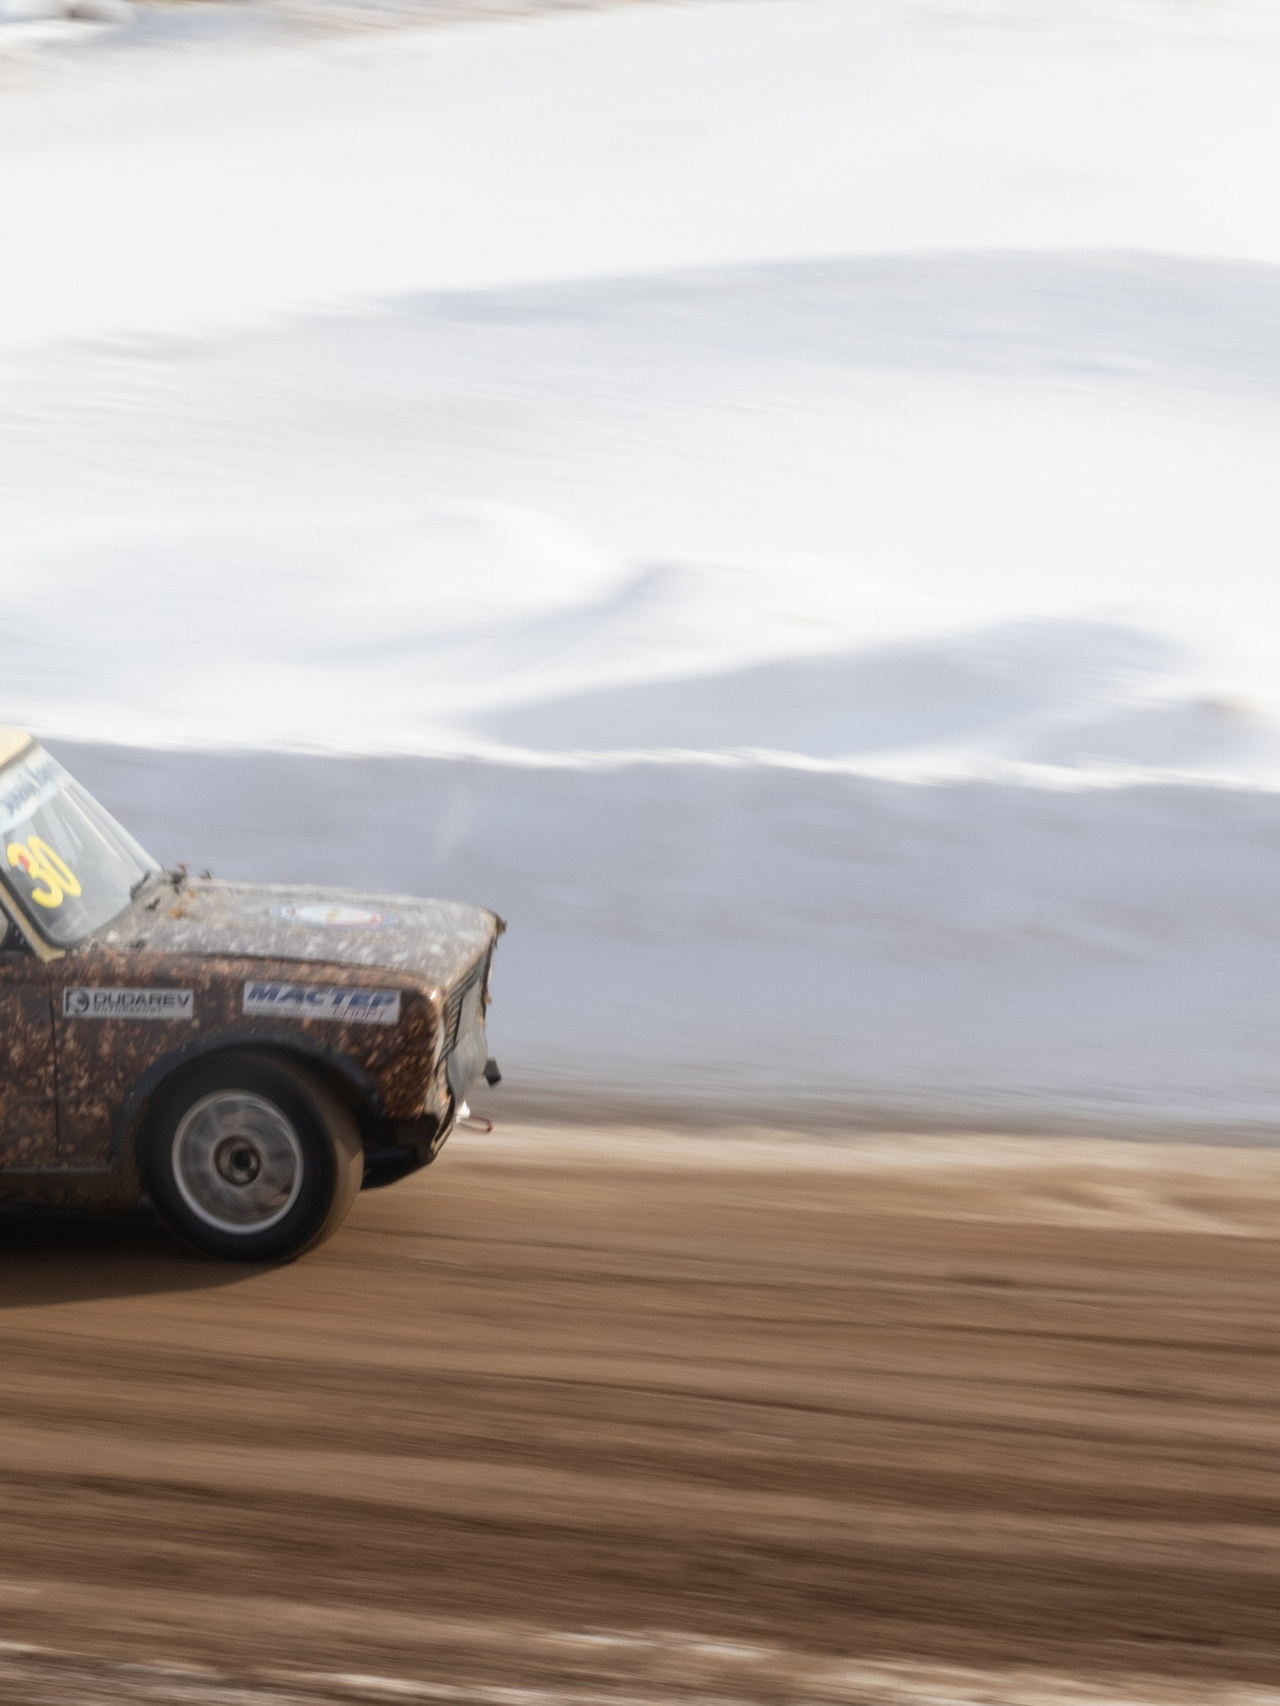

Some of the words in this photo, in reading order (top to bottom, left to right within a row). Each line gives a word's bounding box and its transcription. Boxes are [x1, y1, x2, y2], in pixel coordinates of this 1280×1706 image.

[7, 835, 82, 908] 30
[93, 992, 191, 1008] DUDAREV
[247, 984, 397, 1009] МАСТЕР
